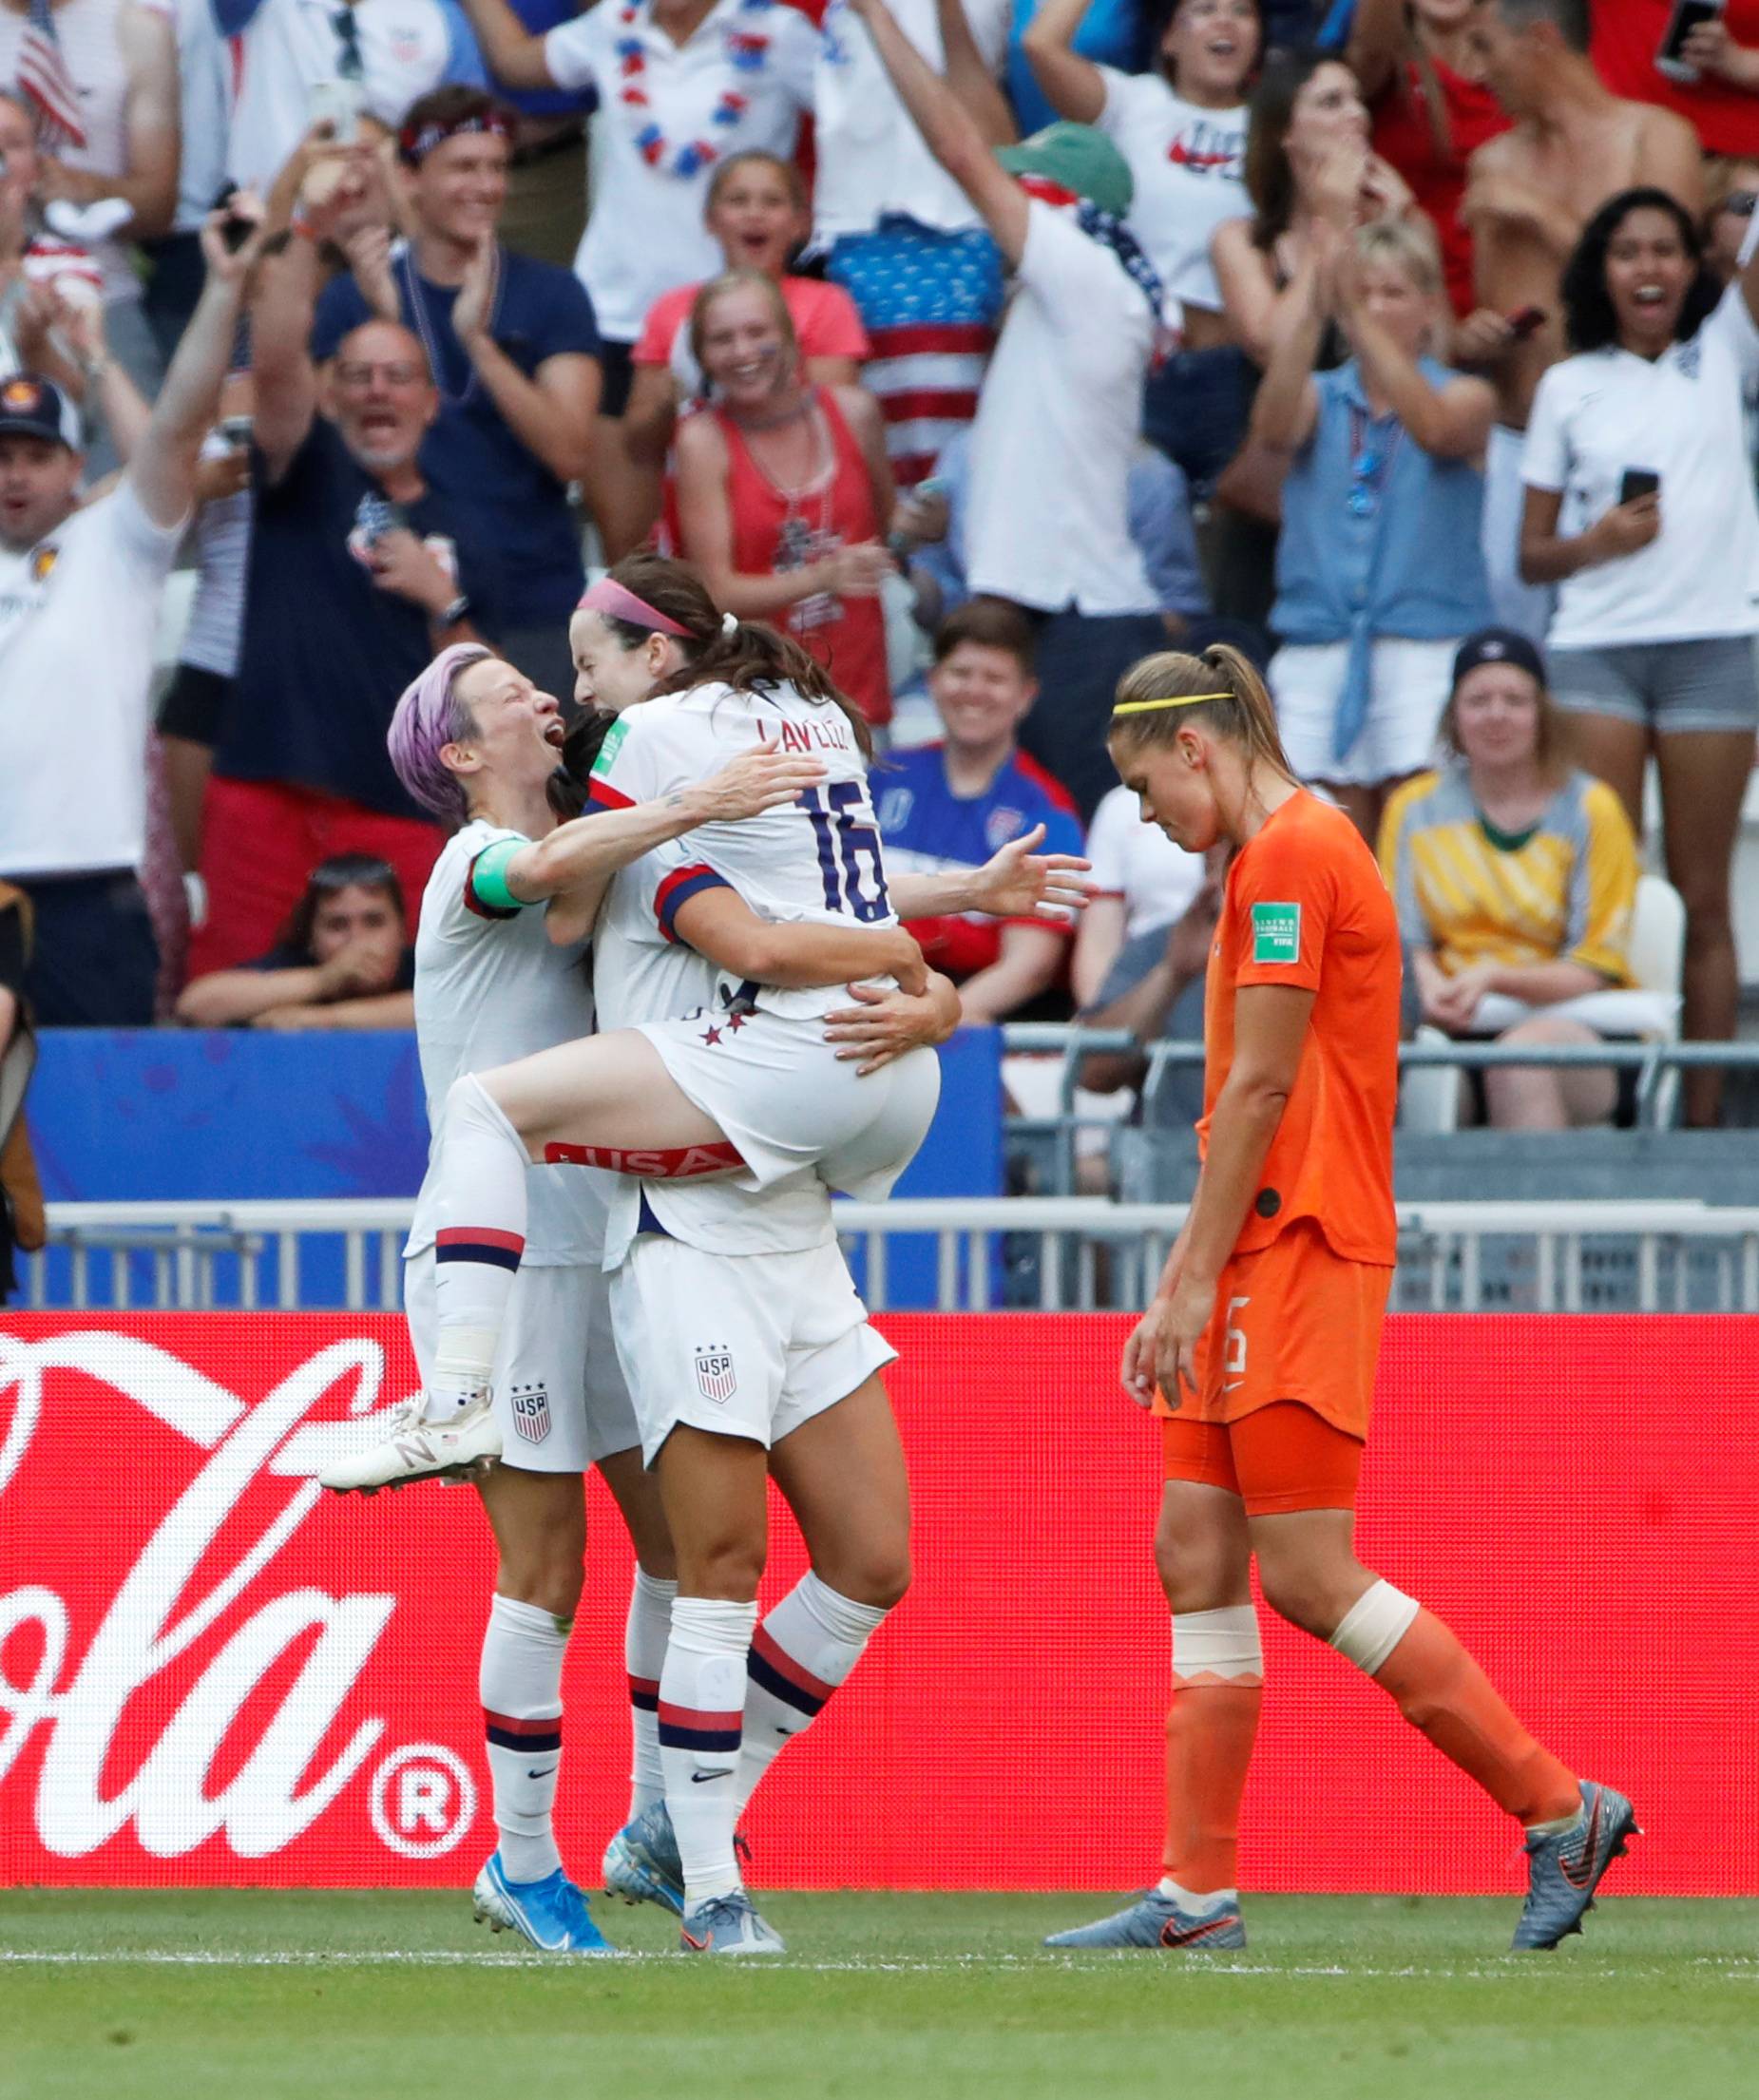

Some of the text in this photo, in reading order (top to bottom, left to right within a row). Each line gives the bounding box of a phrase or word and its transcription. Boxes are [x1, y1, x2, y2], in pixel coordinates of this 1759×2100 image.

[793, 781, 891, 923] 16
[585, 1146, 736, 1177] USA
[698, 1357, 730, 1376] USA
[515, 1396, 545, 1416] USA
[0, 1330, 396, 1859] ola
